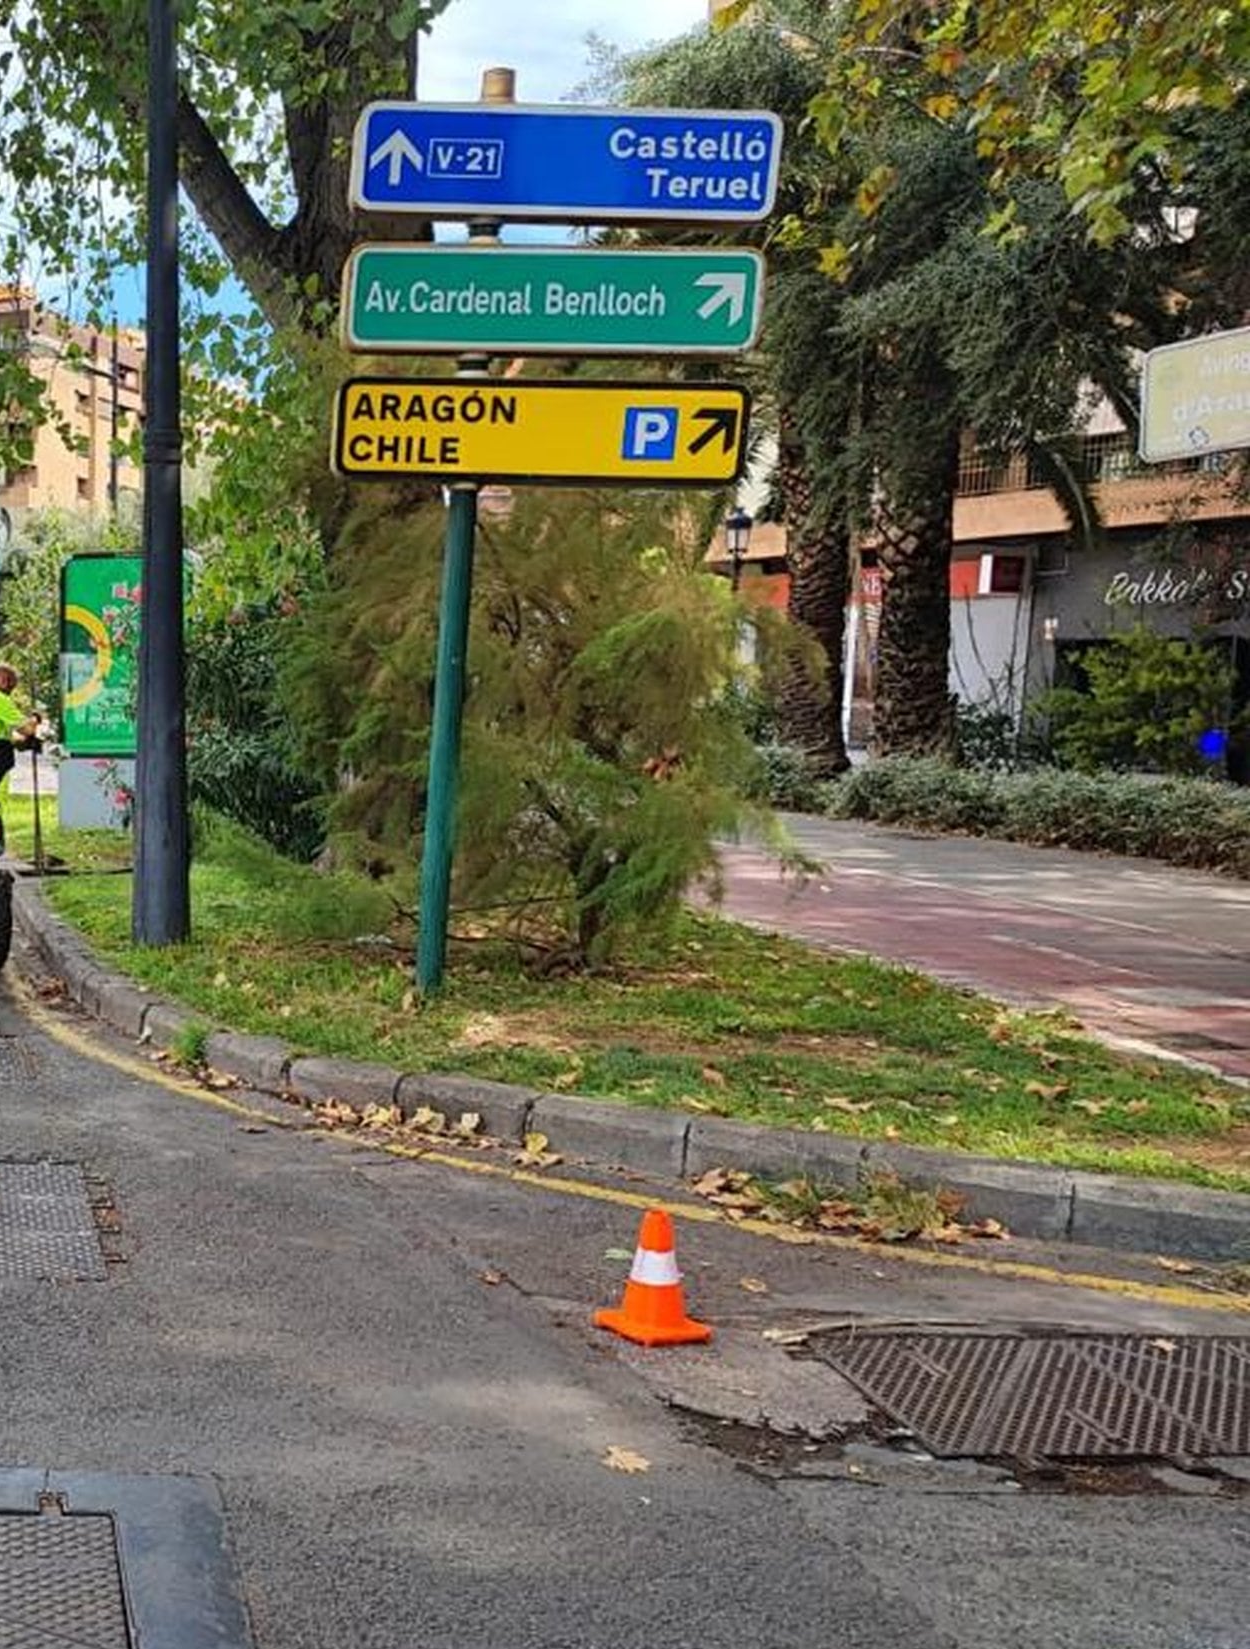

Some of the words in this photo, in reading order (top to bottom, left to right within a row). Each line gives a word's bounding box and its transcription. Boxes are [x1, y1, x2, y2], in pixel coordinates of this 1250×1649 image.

[435, 146, 497, 172] V-21
[609, 128, 767, 161] Castelló
[646, 168, 762, 200] Teruel
[543, 283, 666, 316] Benlloch
[351, 390, 517, 425] ARAGÓN
[348, 434, 461, 465] CHILE
[632, 411, 671, 456] P
